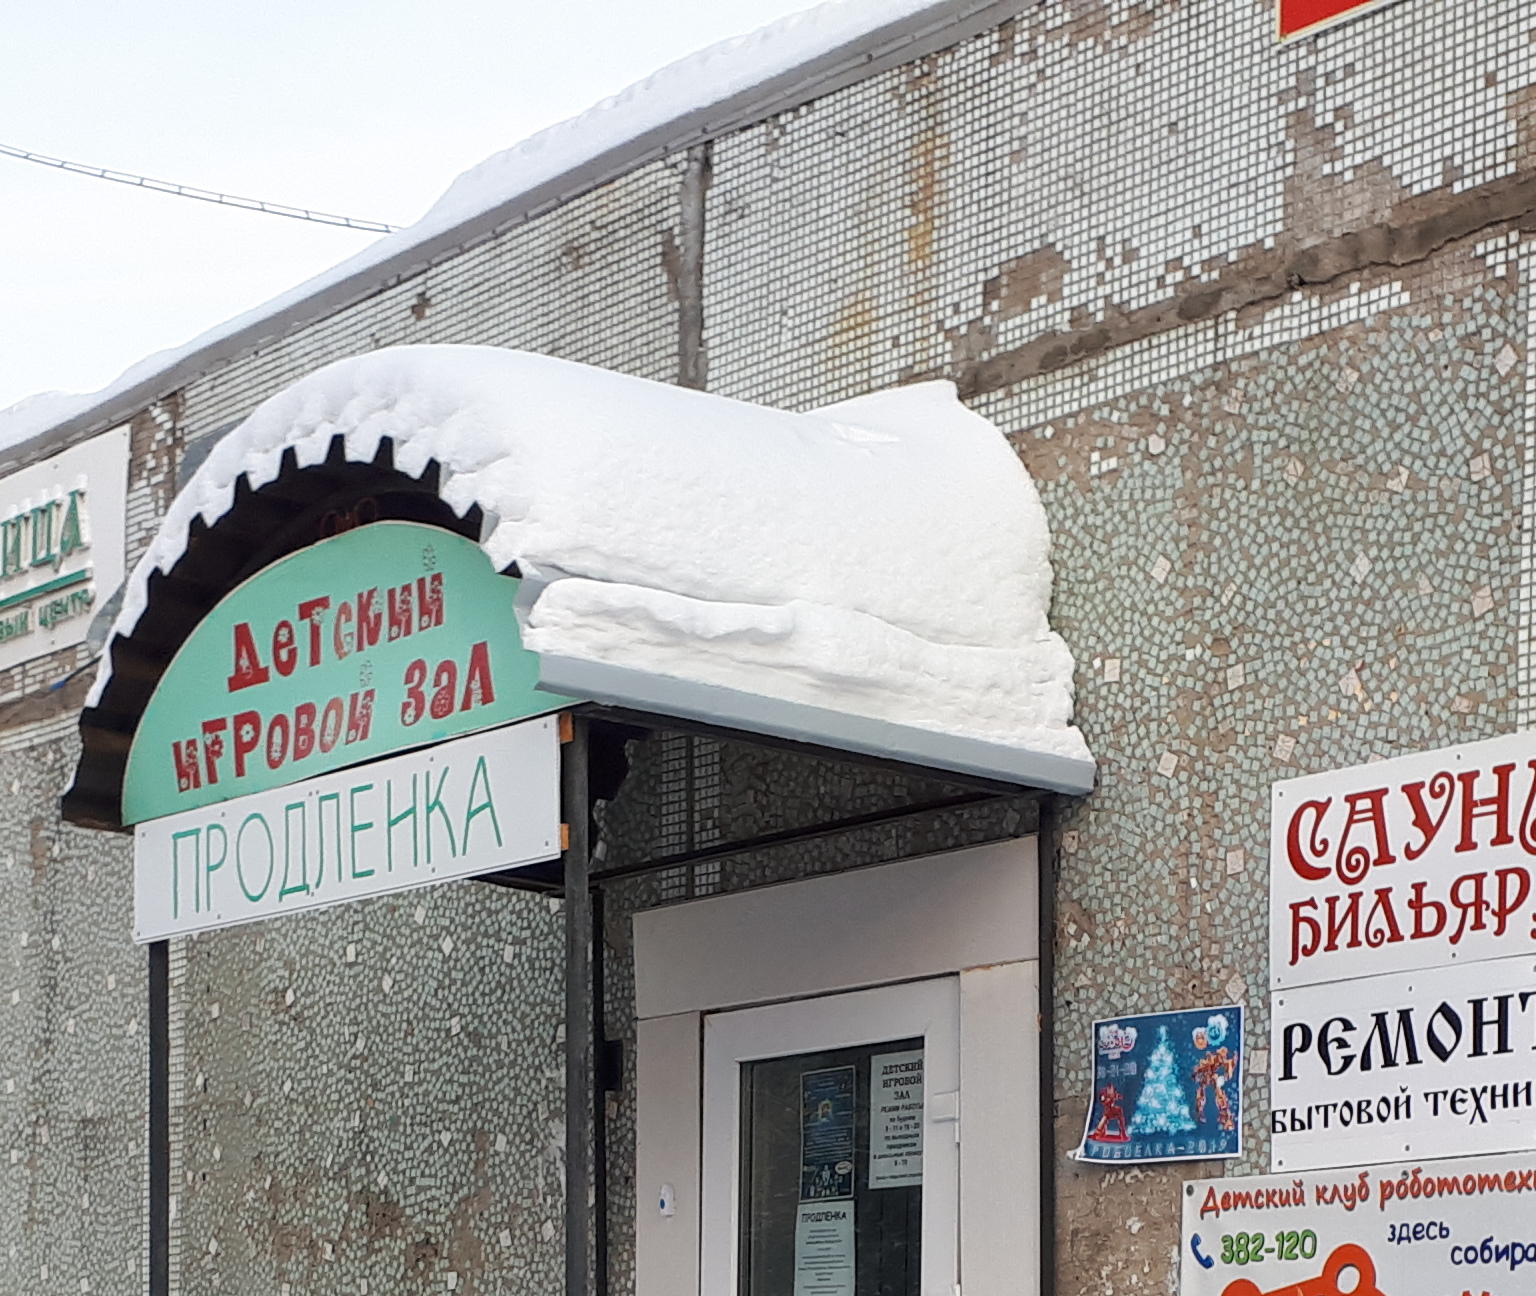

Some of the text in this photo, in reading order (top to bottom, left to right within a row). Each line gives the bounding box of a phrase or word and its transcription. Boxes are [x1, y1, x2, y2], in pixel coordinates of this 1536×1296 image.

[172, 661, 376, 793] ИГРОВОЙ
[172, 755, 503, 920] ПРОДЛЕНКА
[882, 1059, 924, 1075] ДЕТСКИЙ
[882, 1073, 923, 1089] ИГРОВОЙ
[1270, 1084, 1413, 1134] БЫТОВОЙ
[801, 1211, 847, 1223] ПРОДЛЕНКА
[1200, 1180, 1306, 1219] Детский
[1315, 1174, 1372, 1214] клуб
[1220, 1220, 1451, 1266] 382-120 здесь
